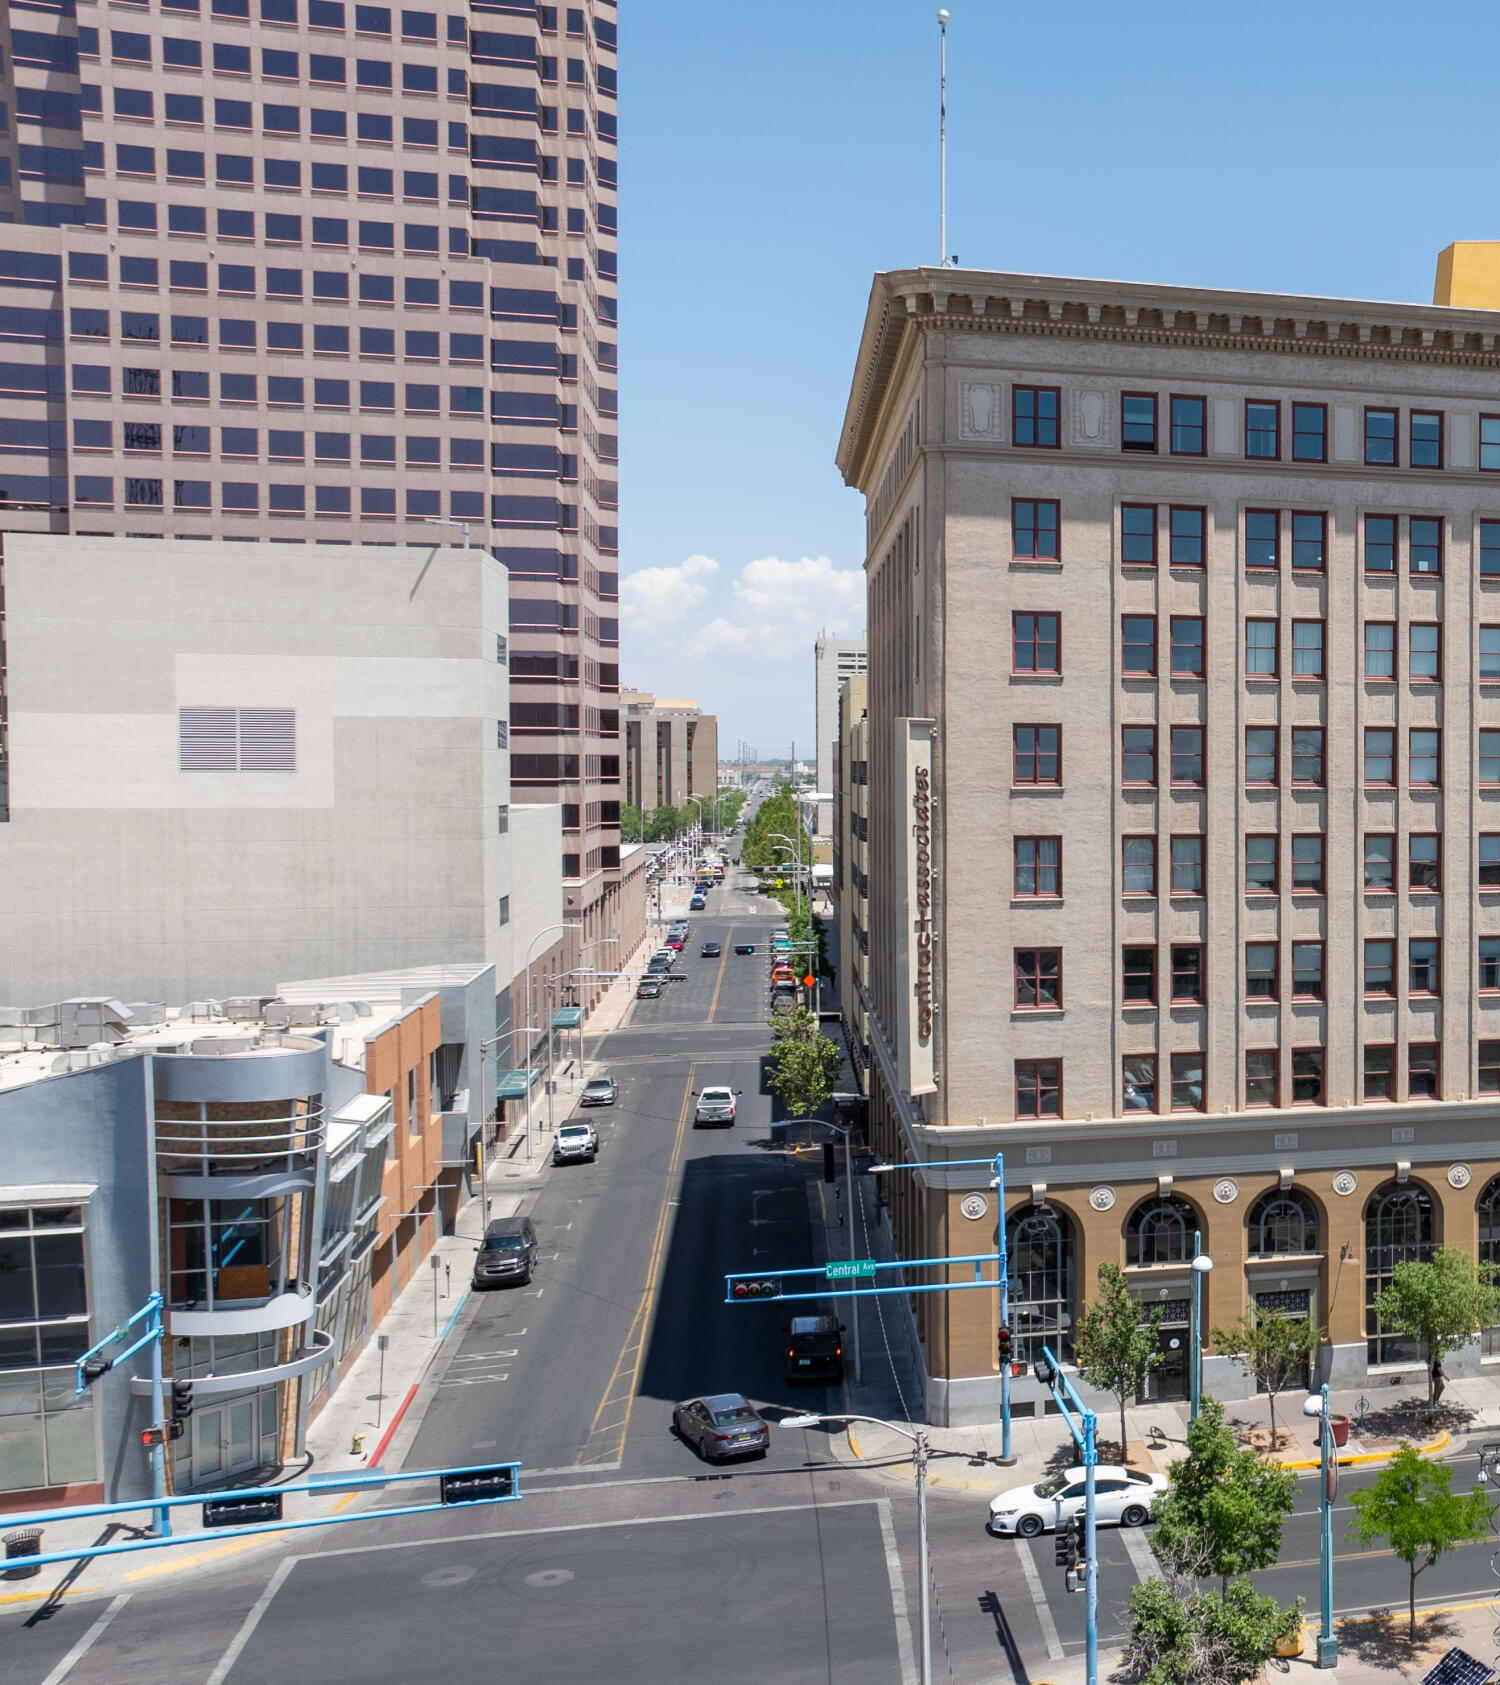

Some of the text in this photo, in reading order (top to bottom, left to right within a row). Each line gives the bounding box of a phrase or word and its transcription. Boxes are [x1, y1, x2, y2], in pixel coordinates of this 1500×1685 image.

[914, 766, 931, 909] associates
[826, 1262, 875, 1277] Central Ave
